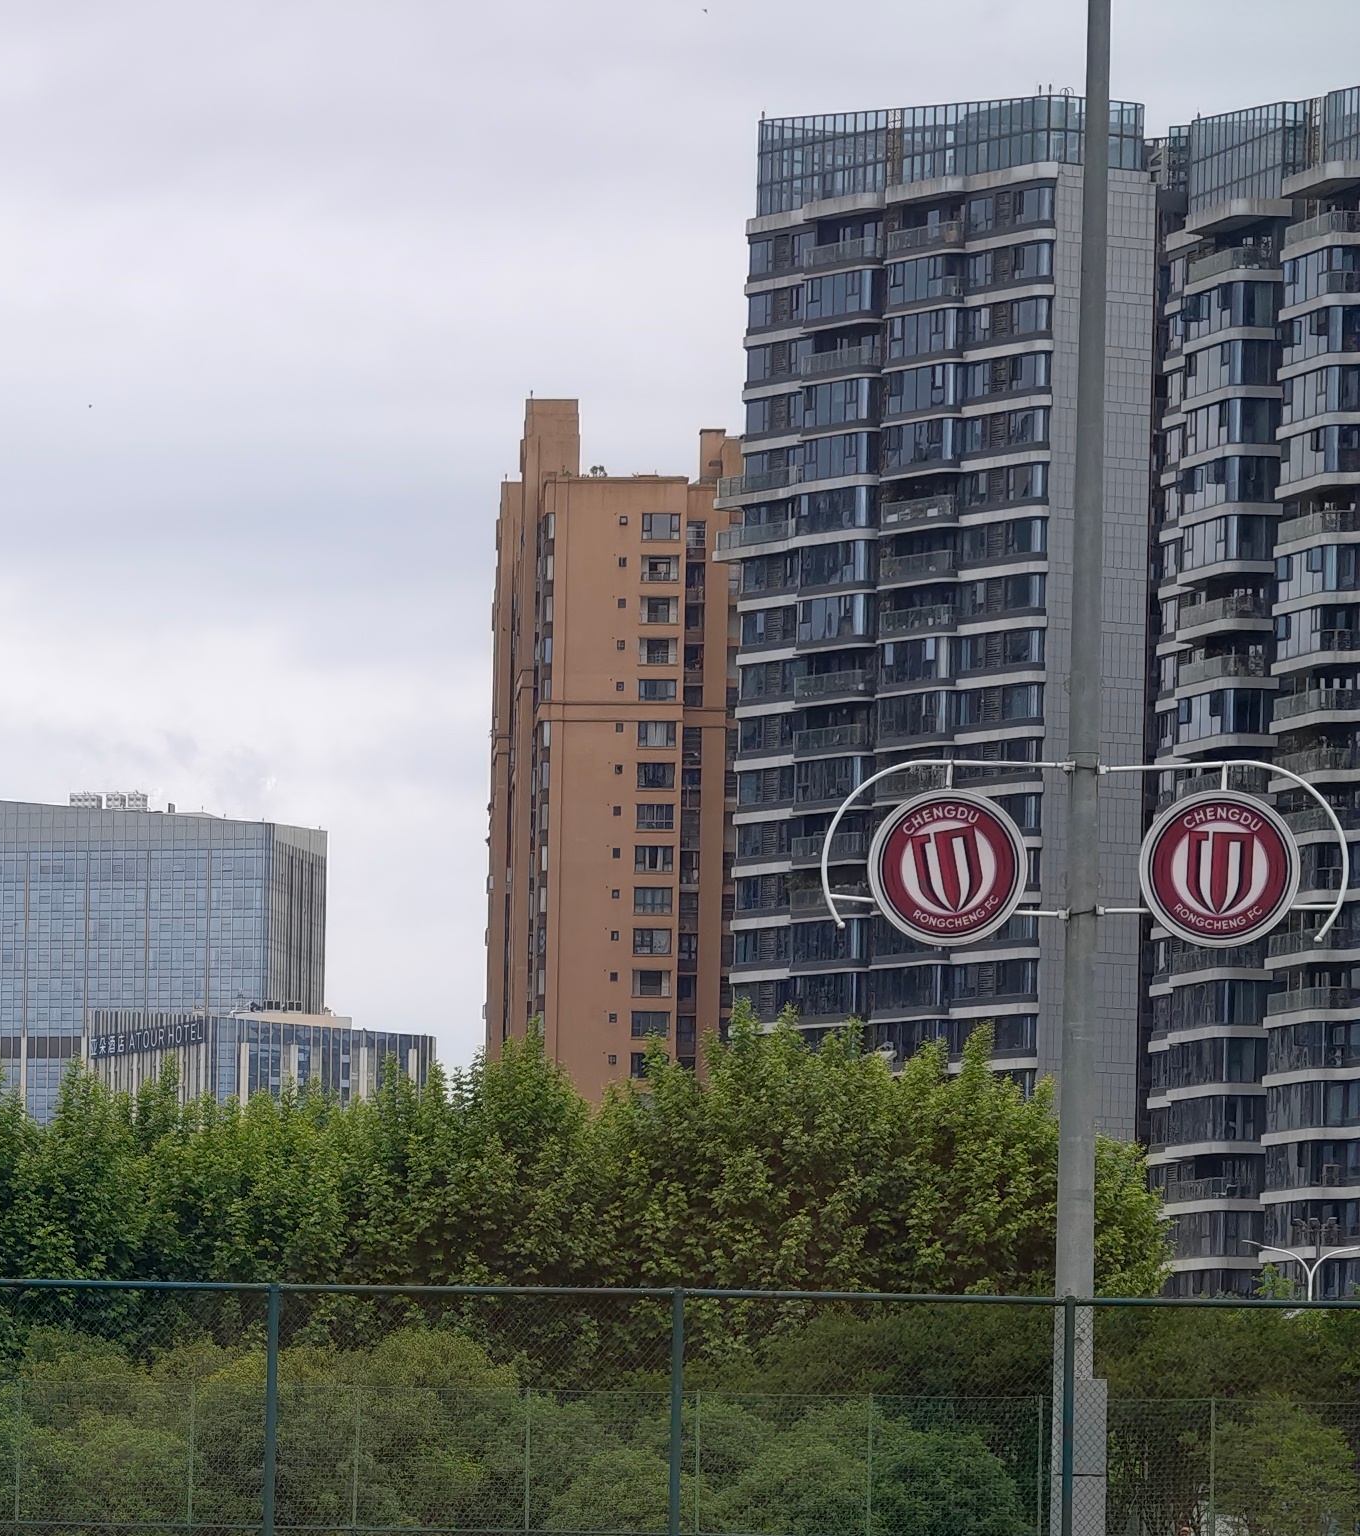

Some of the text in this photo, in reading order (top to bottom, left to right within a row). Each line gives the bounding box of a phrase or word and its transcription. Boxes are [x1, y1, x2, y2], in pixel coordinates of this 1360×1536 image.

[902, 805, 980, 835] CHENGDU
[1183, 806, 1263, 831] CHENGDU
[912, 895, 999, 928] RONGCHENG FC
[1173, 903, 1263, 930] RONGCHENG FC
[129, 1022, 203, 1050] ATOUR HOTEL
